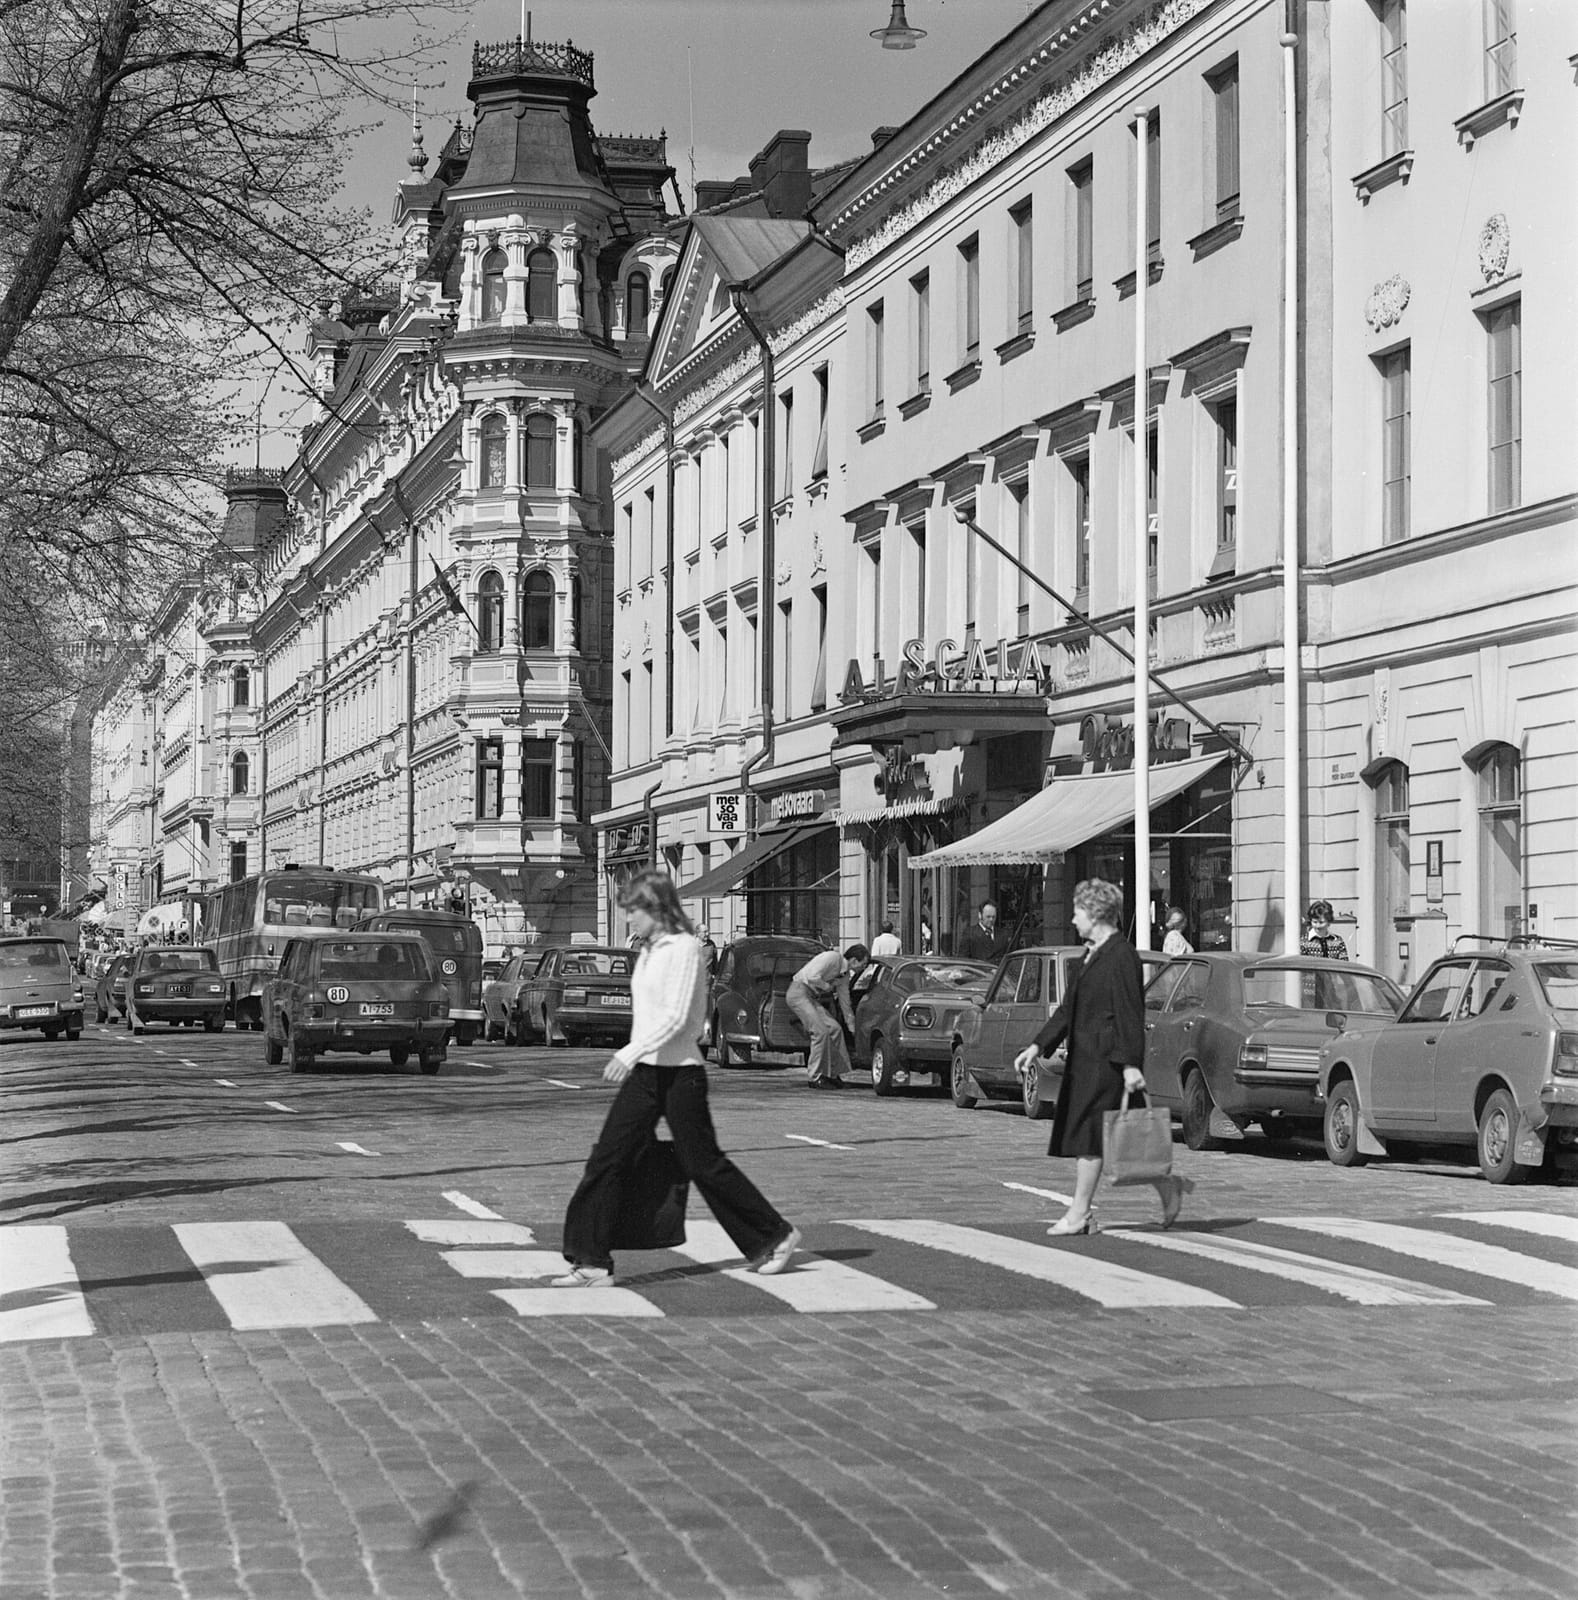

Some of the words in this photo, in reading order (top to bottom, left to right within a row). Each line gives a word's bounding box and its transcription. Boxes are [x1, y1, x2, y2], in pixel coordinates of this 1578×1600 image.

[903, 638, 1045, 681] SCALA
[716, 795, 740, 806] met
[720, 804, 735, 814] so
[716, 812, 738, 822] vaa
[721, 821, 734, 830] ra
[444, 961, 455, 972] 80
[330, 988, 345, 1001] 80
